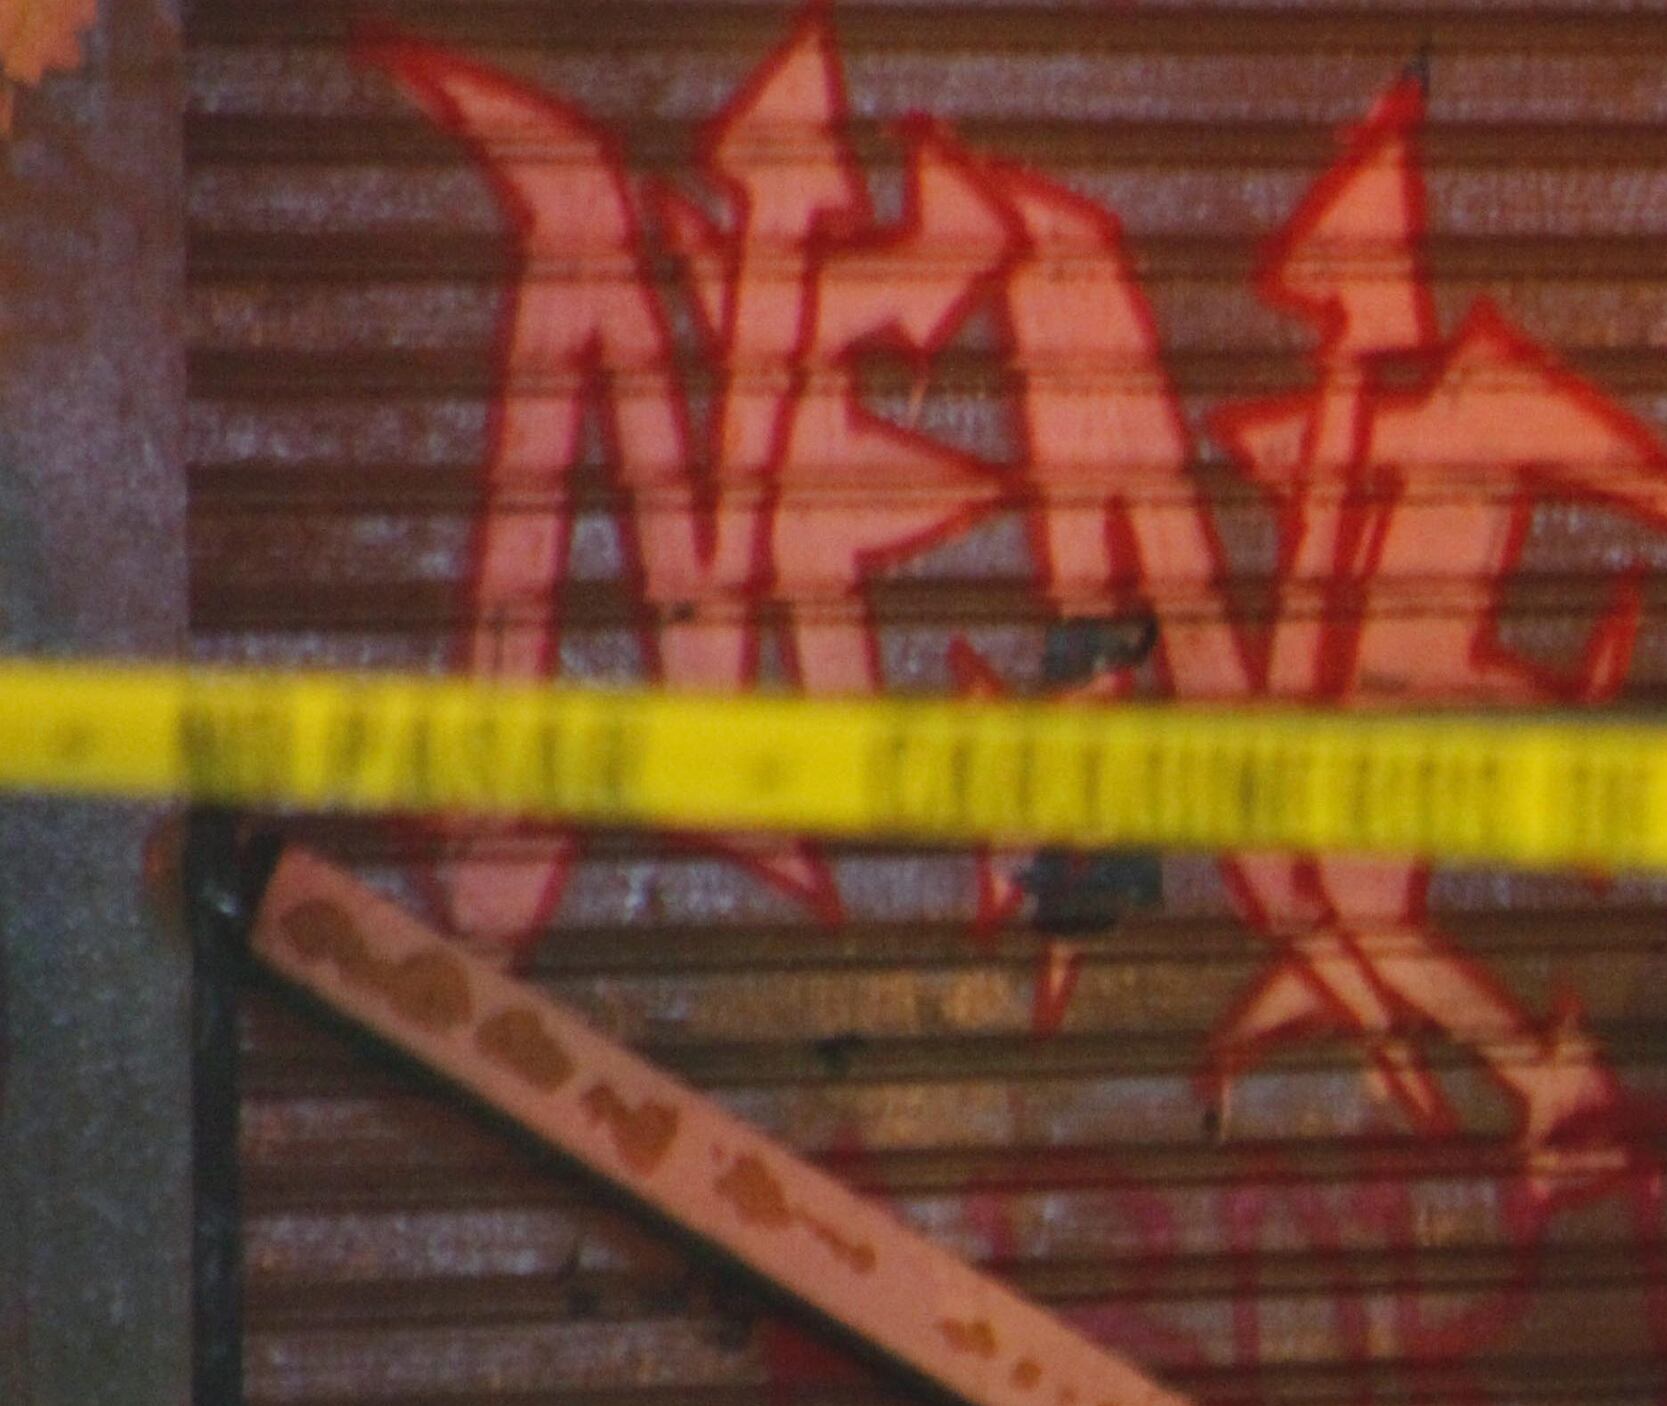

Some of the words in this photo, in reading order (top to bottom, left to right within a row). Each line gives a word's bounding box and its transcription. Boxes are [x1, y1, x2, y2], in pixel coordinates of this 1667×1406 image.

[172, 684, 296, 788] NO
[320, 694, 638, 803] PASAR
[868, 717, 1502, 847] CARABINEROS
[1562, 752, 1646, 858] DE
